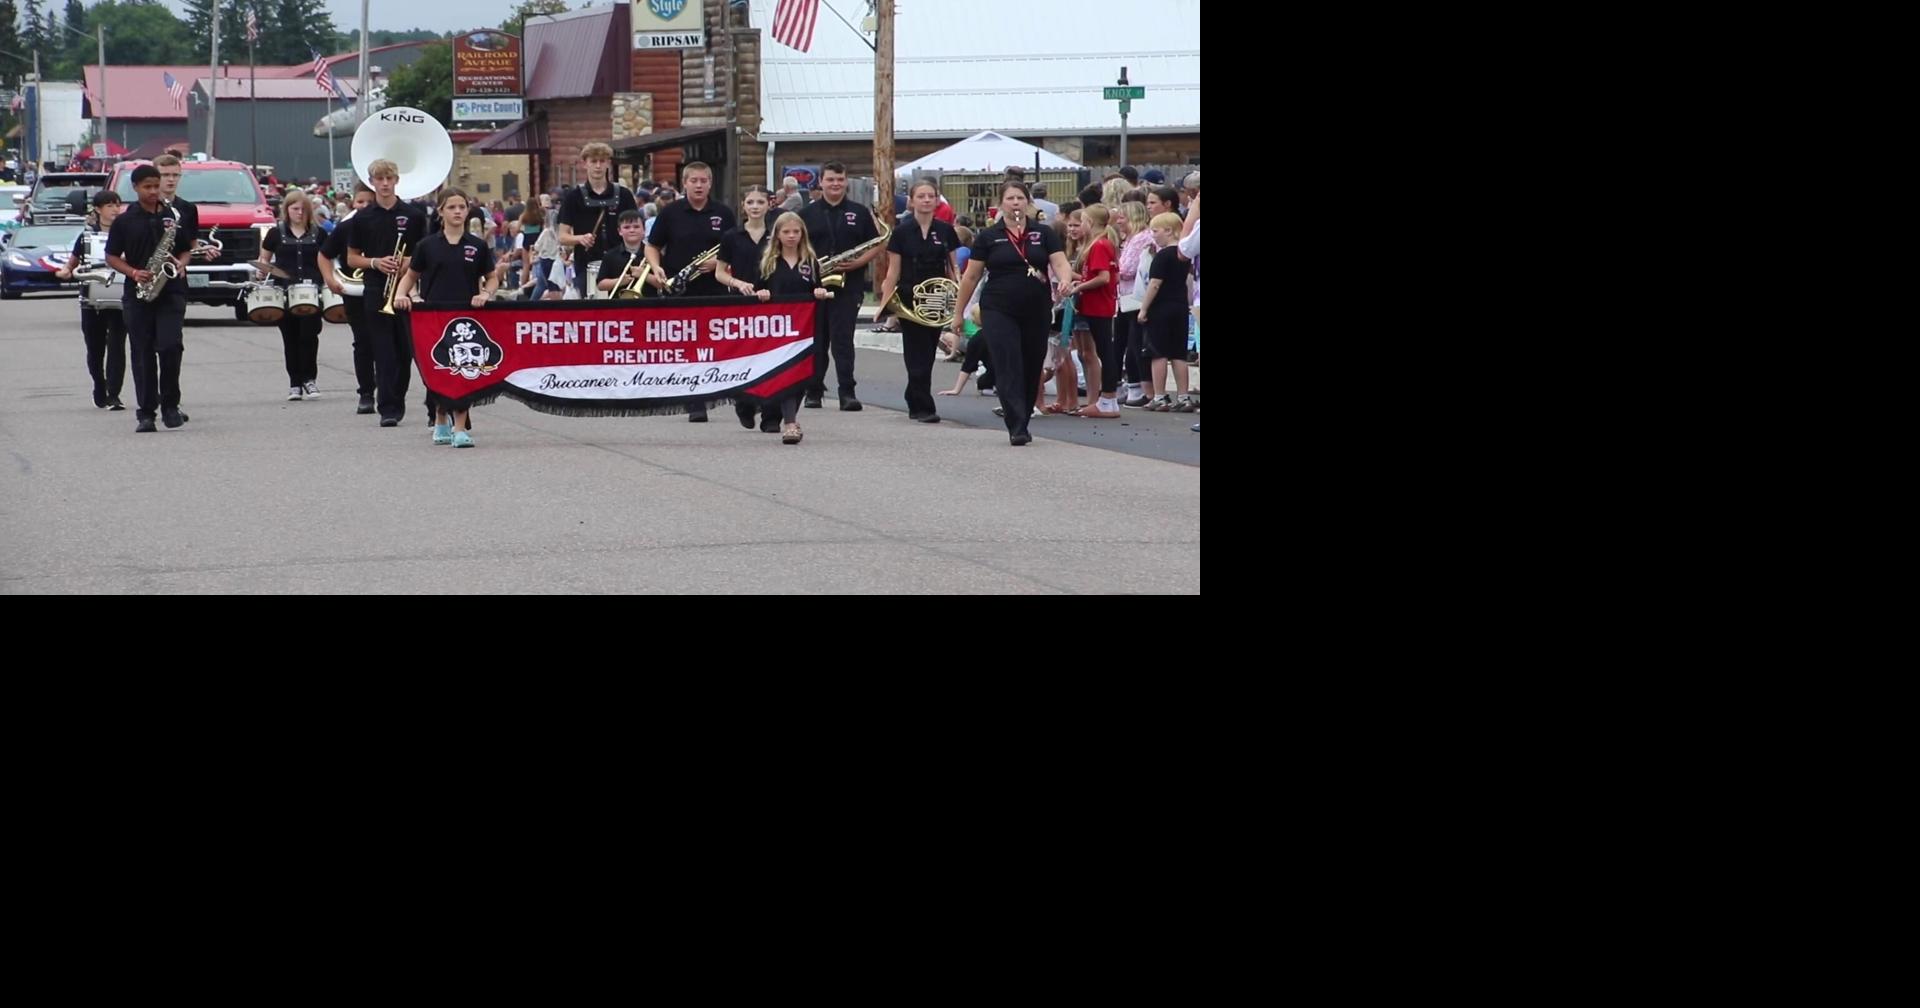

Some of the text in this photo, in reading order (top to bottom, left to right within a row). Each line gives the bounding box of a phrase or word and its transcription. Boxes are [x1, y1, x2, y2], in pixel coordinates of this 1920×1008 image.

[651, 35, 701, 46] RIPSAW
[457, 52, 517, 60] RAILROAD
[1105, 88, 1132, 99] KNOX
[471, 102, 521, 113] Price County
[380, 113, 425, 124] KING
[515, 314, 800, 345] PRENTICE HIGH SCHOOL
[696, 347, 714, 362] WI
[539, 366, 752, 392] Buccaneer Marching Band
